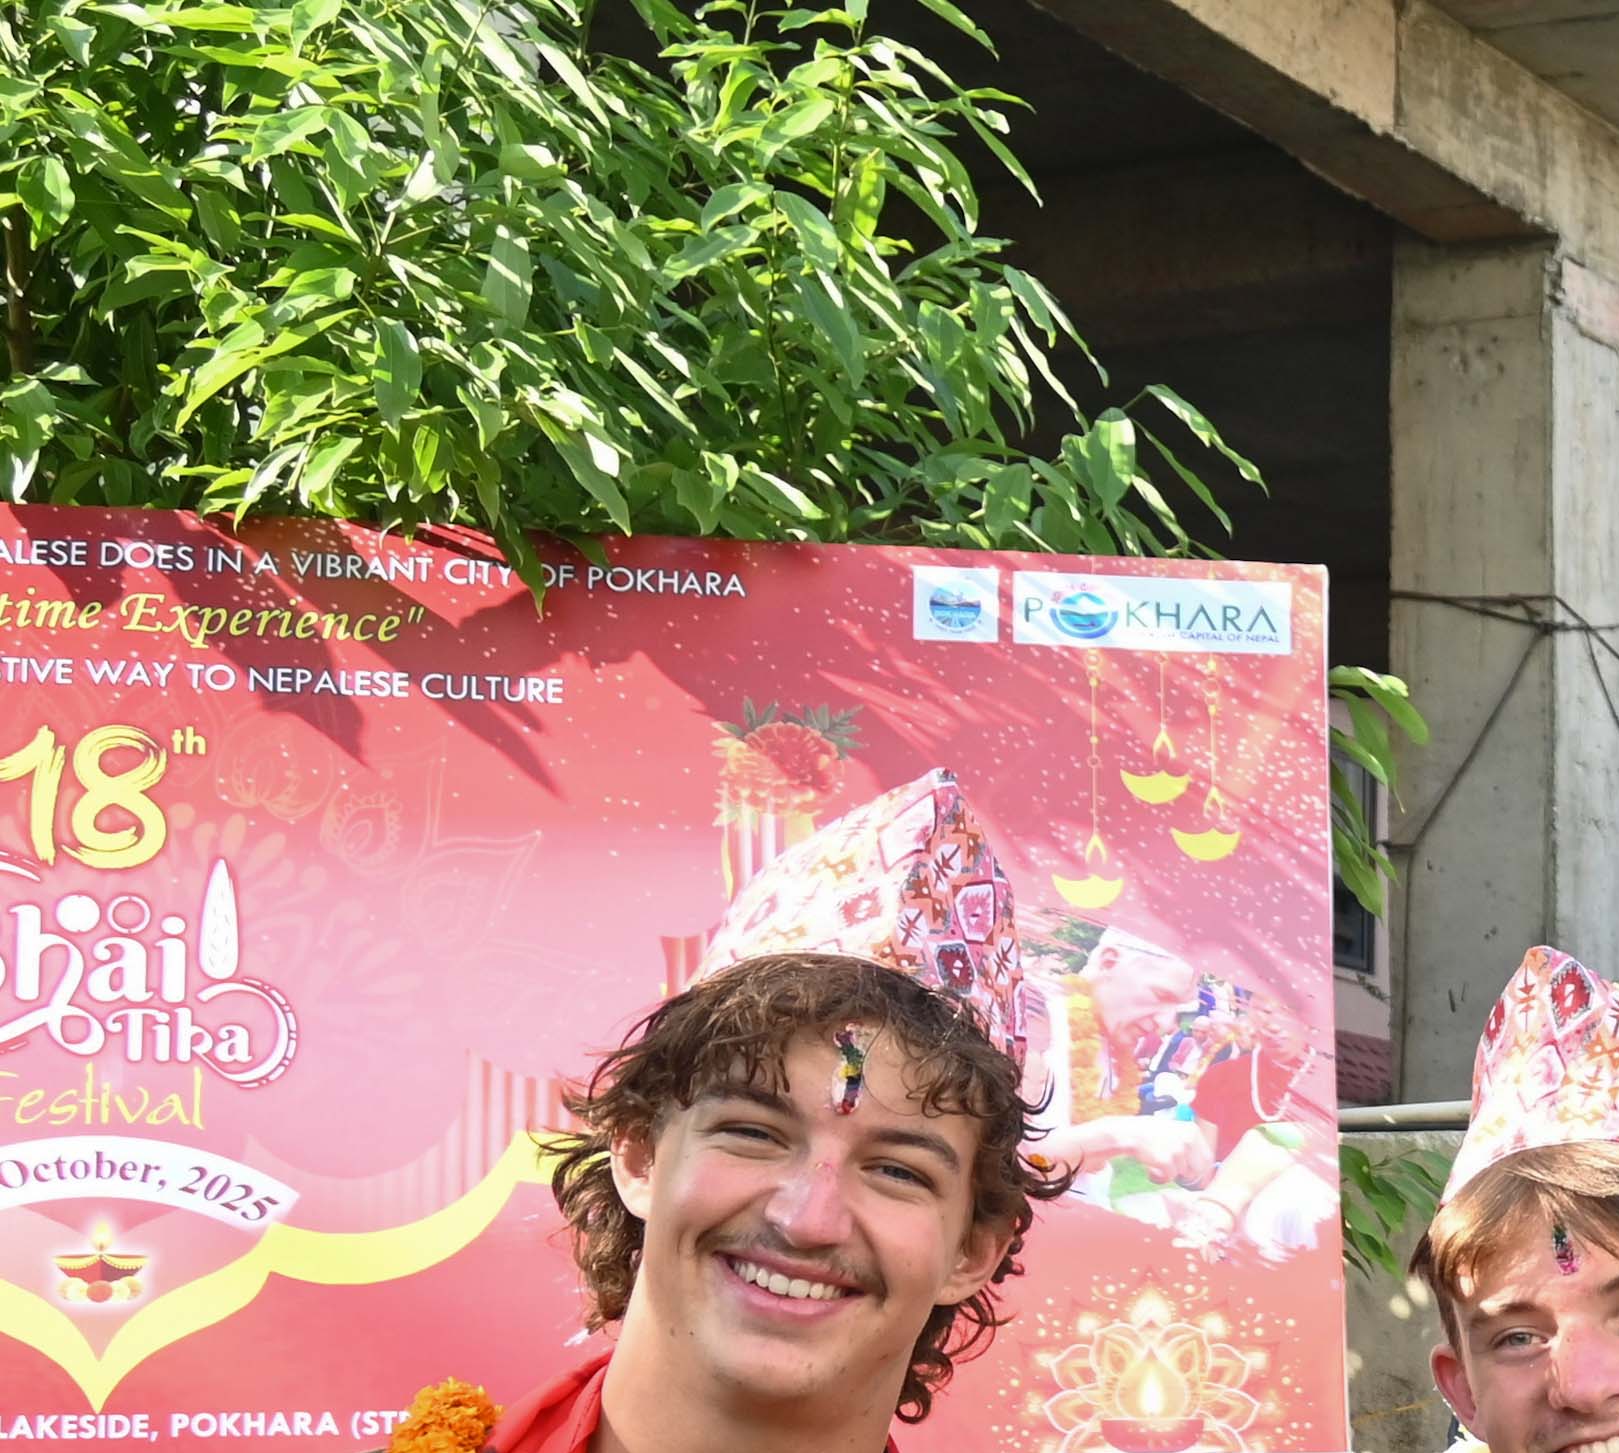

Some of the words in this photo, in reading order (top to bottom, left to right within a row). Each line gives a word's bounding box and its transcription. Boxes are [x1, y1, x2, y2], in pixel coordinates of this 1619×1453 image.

[100, 541, 194, 571] DOES
[207, 547, 243, 575] IN
[254, 552, 279, 577] A
[292, 552, 433, 582] VIBRANT
[443, 557, 512, 587] CITY
[587, 565, 747, 598] POKHARA
[119, 592, 425, 649] Experience"
[0, 656, 74, 685] TIVE
[84, 658, 175, 688] WAY
[186, 663, 237, 691] TO
[248, 666, 410, 698] NEPALESE
[420, 672, 564, 704] CULTURE
[0, 1151, 168, 1193] October,
[178, 1165, 280, 1222] 2025
[171, 1411, 339, 1438] POKHARA
